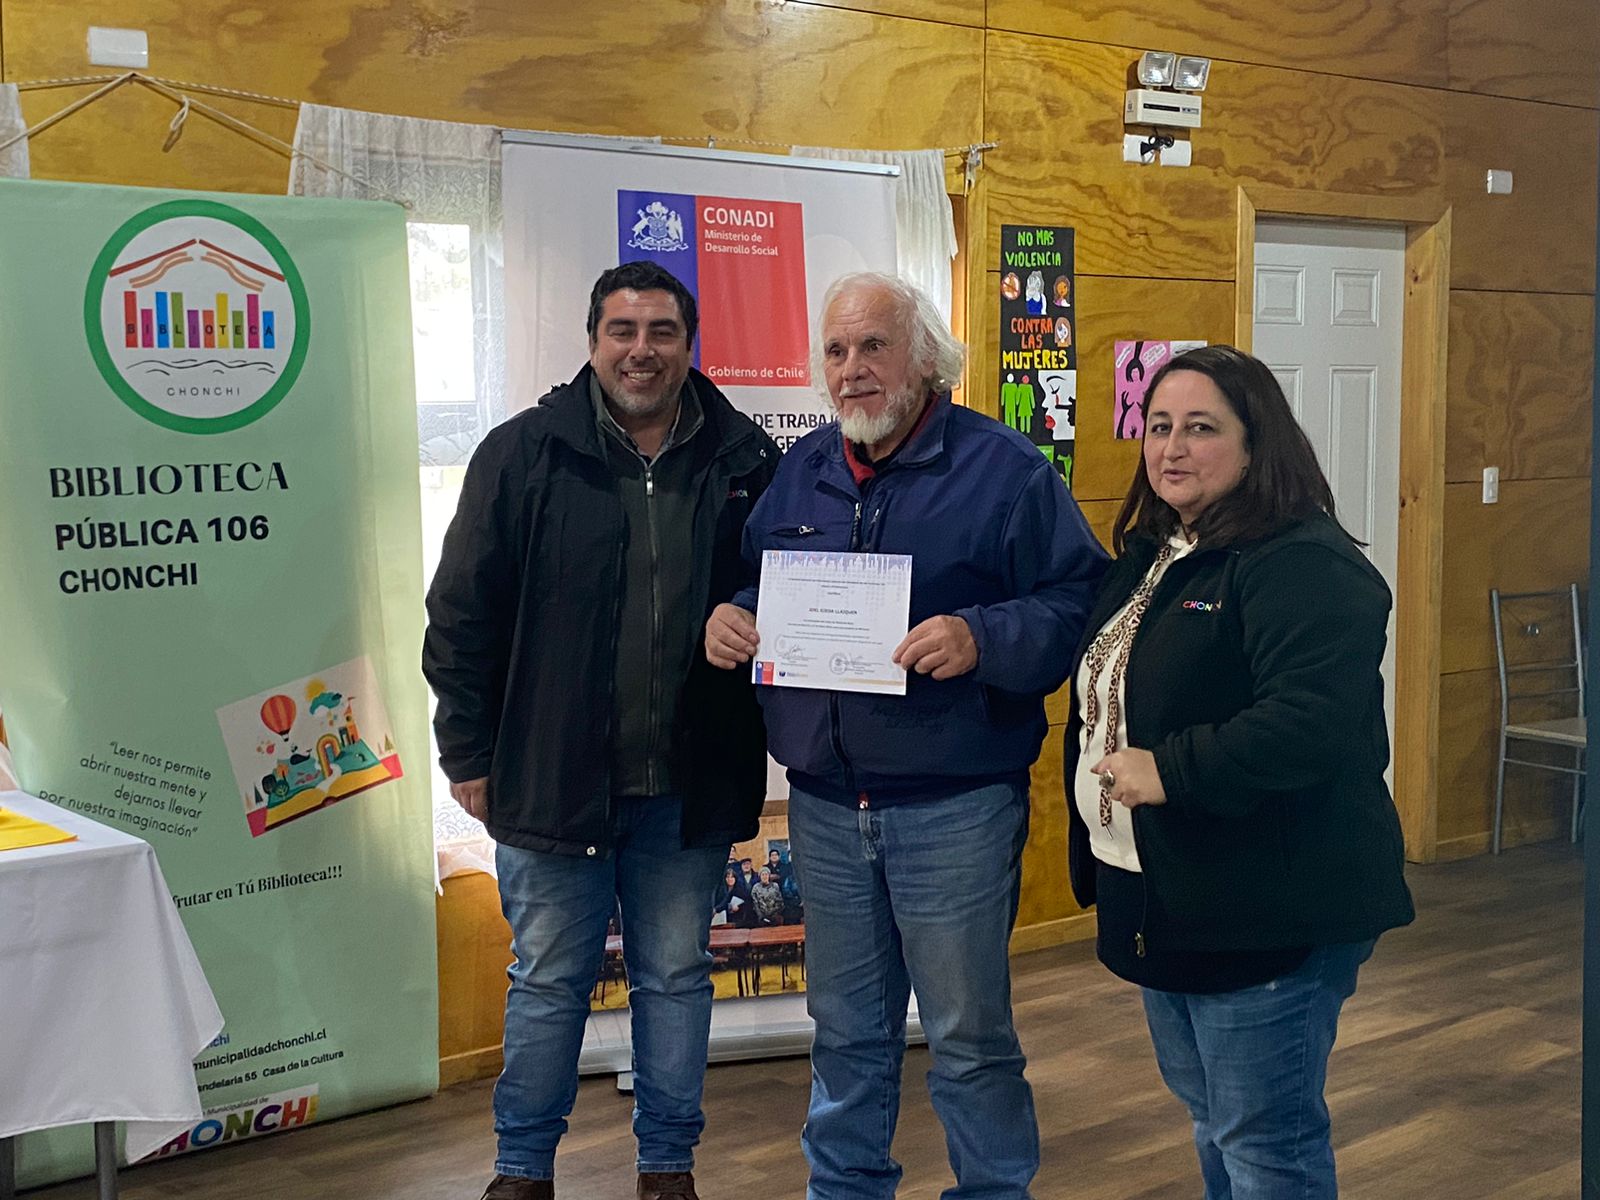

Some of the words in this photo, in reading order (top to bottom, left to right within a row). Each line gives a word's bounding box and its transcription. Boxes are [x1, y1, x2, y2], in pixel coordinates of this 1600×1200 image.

[703, 206, 775, 229] CONADI
[704, 229, 750, 242] Ministerio
[751, 232, 762, 243] de
[1017, 231, 1034, 247] NO
[1036, 229, 1055, 246] MAS
[705, 242, 751, 255] Desarrollo
[751, 245, 779, 257] Social
[1005, 251, 1062, 268] VIOLENCIA
[126, 323, 274, 337] BIBLIOTECA
[1011, 317, 1053, 334] CONTRA
[1021, 334, 1043, 350] LAS
[1002, 350, 1068, 370] MUJERES
[708, 366, 758, 378] Gobierno
[760, 367, 774, 378] de
[776, 367, 805, 379] Chile
[167, 387, 241, 397] CHONCHI
[753, 413, 774, 428] DE
[776, 413, 839, 428] TRABAJ
[49, 461, 289, 499] BIBLIOTECA
[55, 517, 199, 550] PÚBLICA
[207, 515, 270, 543] 106
[59, 562, 198, 595] CHONCHI
[142, 752, 162, 768] nos
[164, 760, 212, 781] permite
[80, 754, 112, 774] abrir
[114, 767, 157, 787] nuestra
[160, 779, 197, 798] mente
[199, 790, 208, 804] y
[39, 789, 66, 804] por
[67, 798, 116, 819] nuestra
[168, 799, 203, 821] llevar
[216, 887, 233, 901] en
[235, 879, 255, 896] Tú
[258, 864, 343, 893] Biblioteca!!!
[206, 1033, 230, 1049] chi
[262, 1066, 286, 1078] Casa
[287, 1059, 300, 1071] de
[300, 1057, 309, 1068] la
[310, 1049, 345, 1066] Cultura
[207, 1097, 258, 1116] Municipalidad
[140, 1094, 319, 1161] HONCHI
